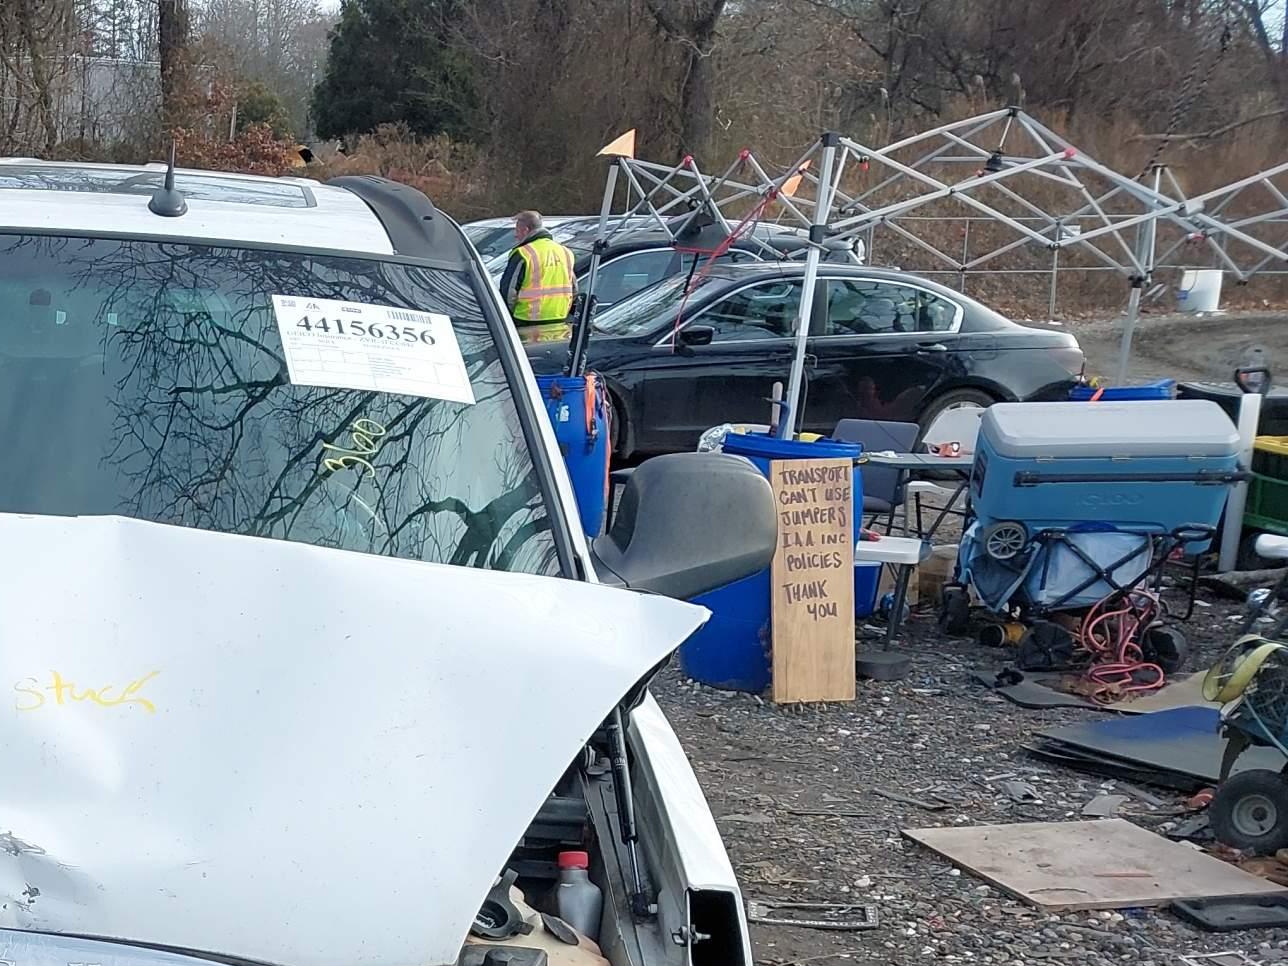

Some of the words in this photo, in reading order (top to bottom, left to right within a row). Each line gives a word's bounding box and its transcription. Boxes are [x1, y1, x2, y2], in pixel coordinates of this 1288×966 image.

[296, 315, 436, 346] 44156356
[778, 465, 850, 486] TRANSPORT
[779, 487, 817, 506] CAN'T
[824, 486, 851, 502] USE
[780, 506, 847, 528] JUMPERS
[782, 579, 829, 605] THANK
[806, 602, 838, 622] YOU
